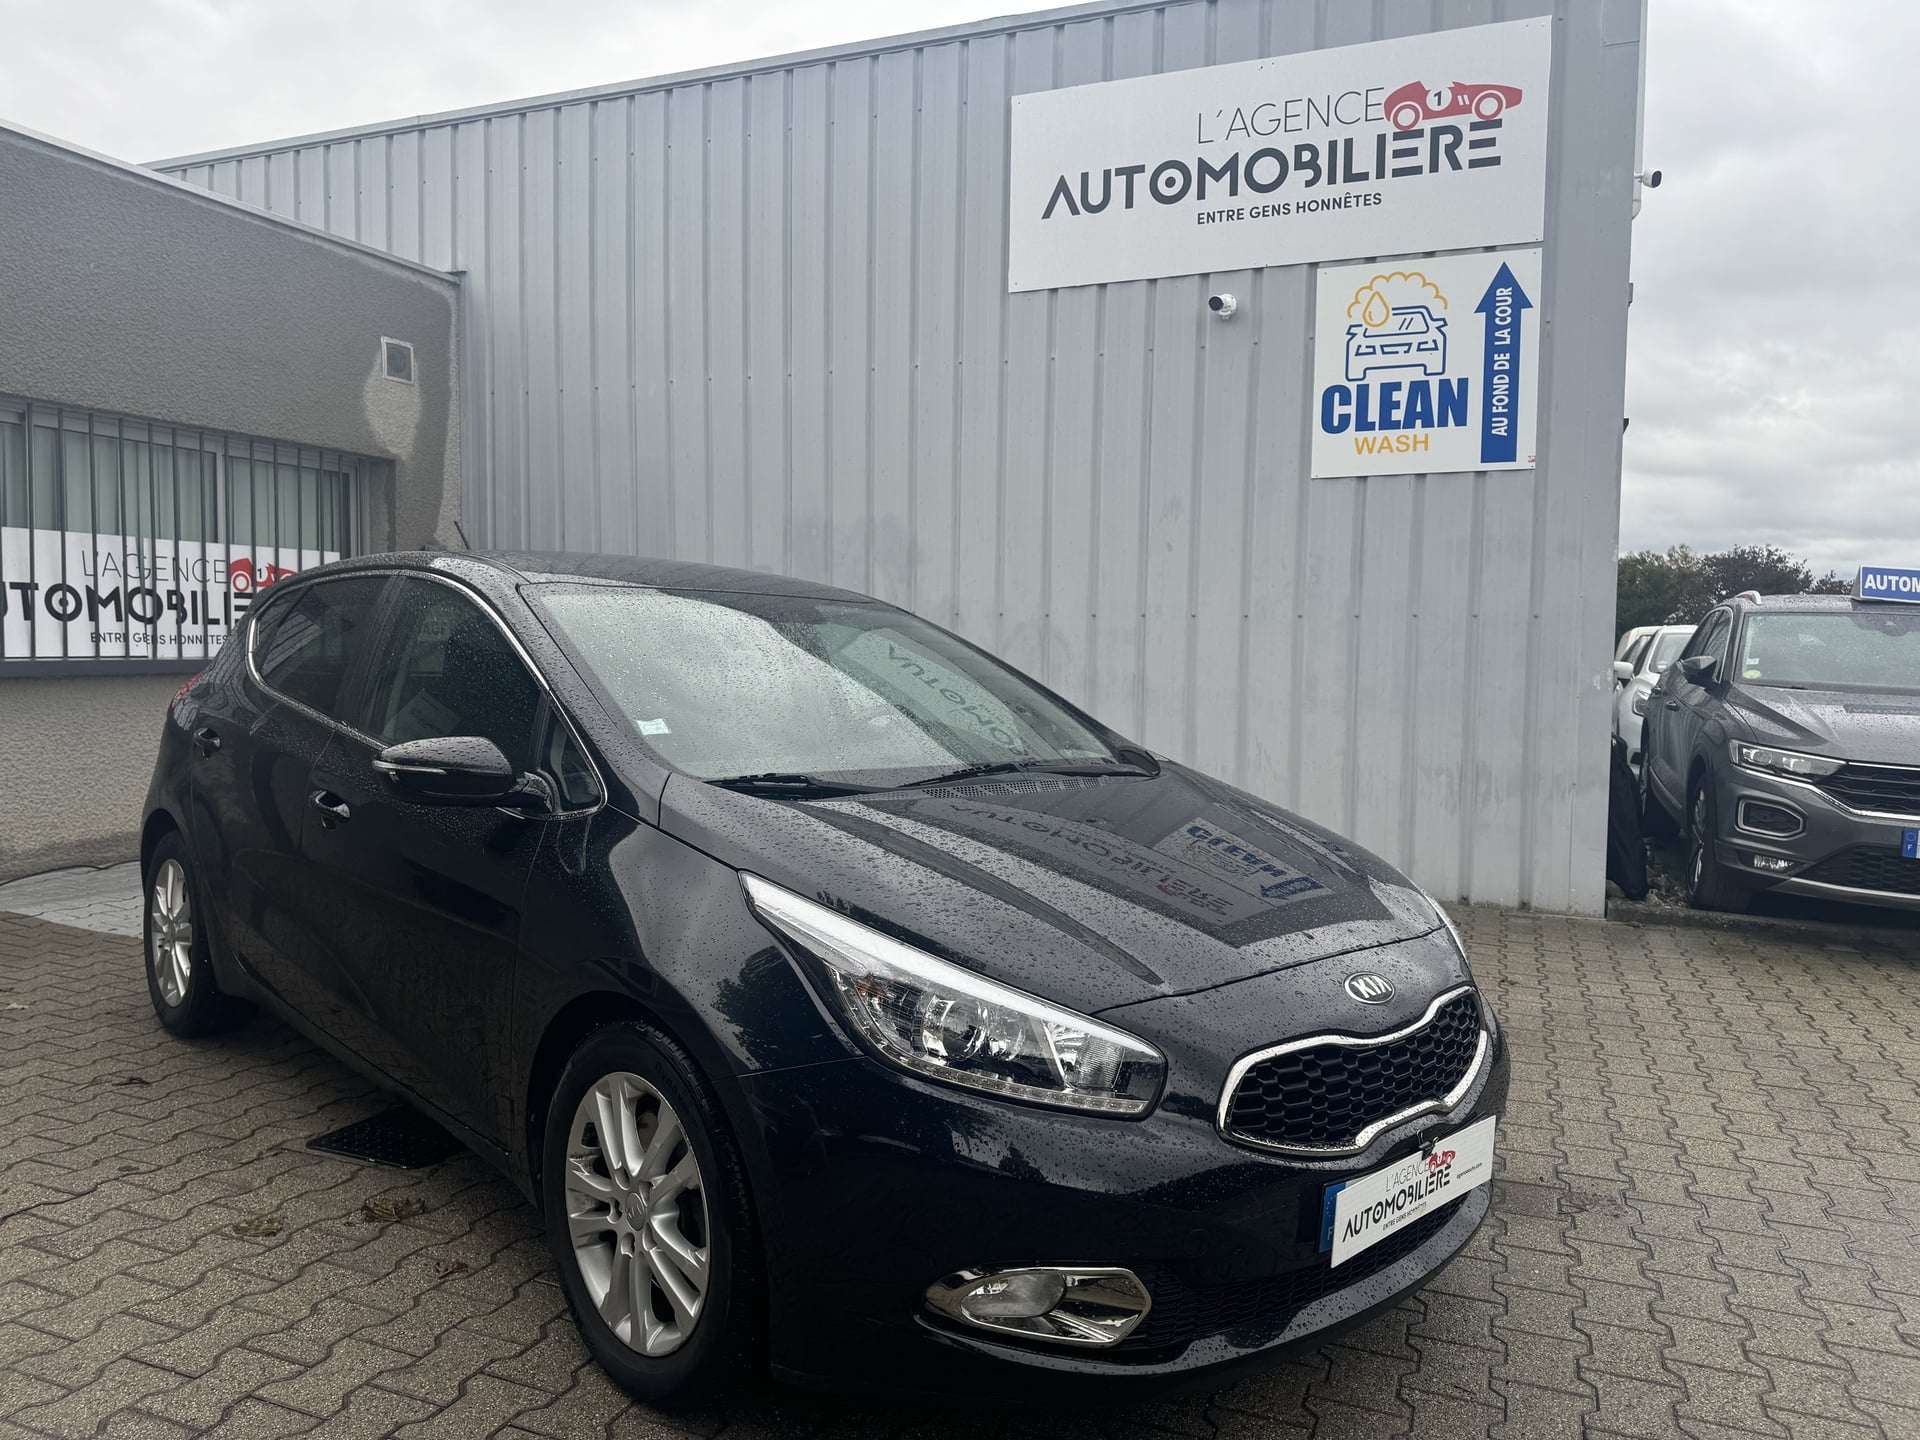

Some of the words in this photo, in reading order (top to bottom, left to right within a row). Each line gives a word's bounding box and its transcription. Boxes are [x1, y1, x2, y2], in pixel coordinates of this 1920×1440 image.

[1198, 87, 1385, 144] L'AGENCE
[1197, 208, 1245, 225] ENTRE
[1250, 203, 1291, 219] GENS
[1296, 192, 1382, 214] HONNÊTES
[1495, 287, 1513, 325] COUR
[1494, 328, 1511, 345] LA
[1493, 353, 1510, 370] DE
[1492, 374, 1509, 413] FOND
[1321, 377, 1469, 434] CLEAN
[1491, 417, 1507, 436] AU
[1354, 433, 1429, 455] WASH
[170, 635, 228, 645] HONNTES
[1351, 976, 1392, 998] KIA
